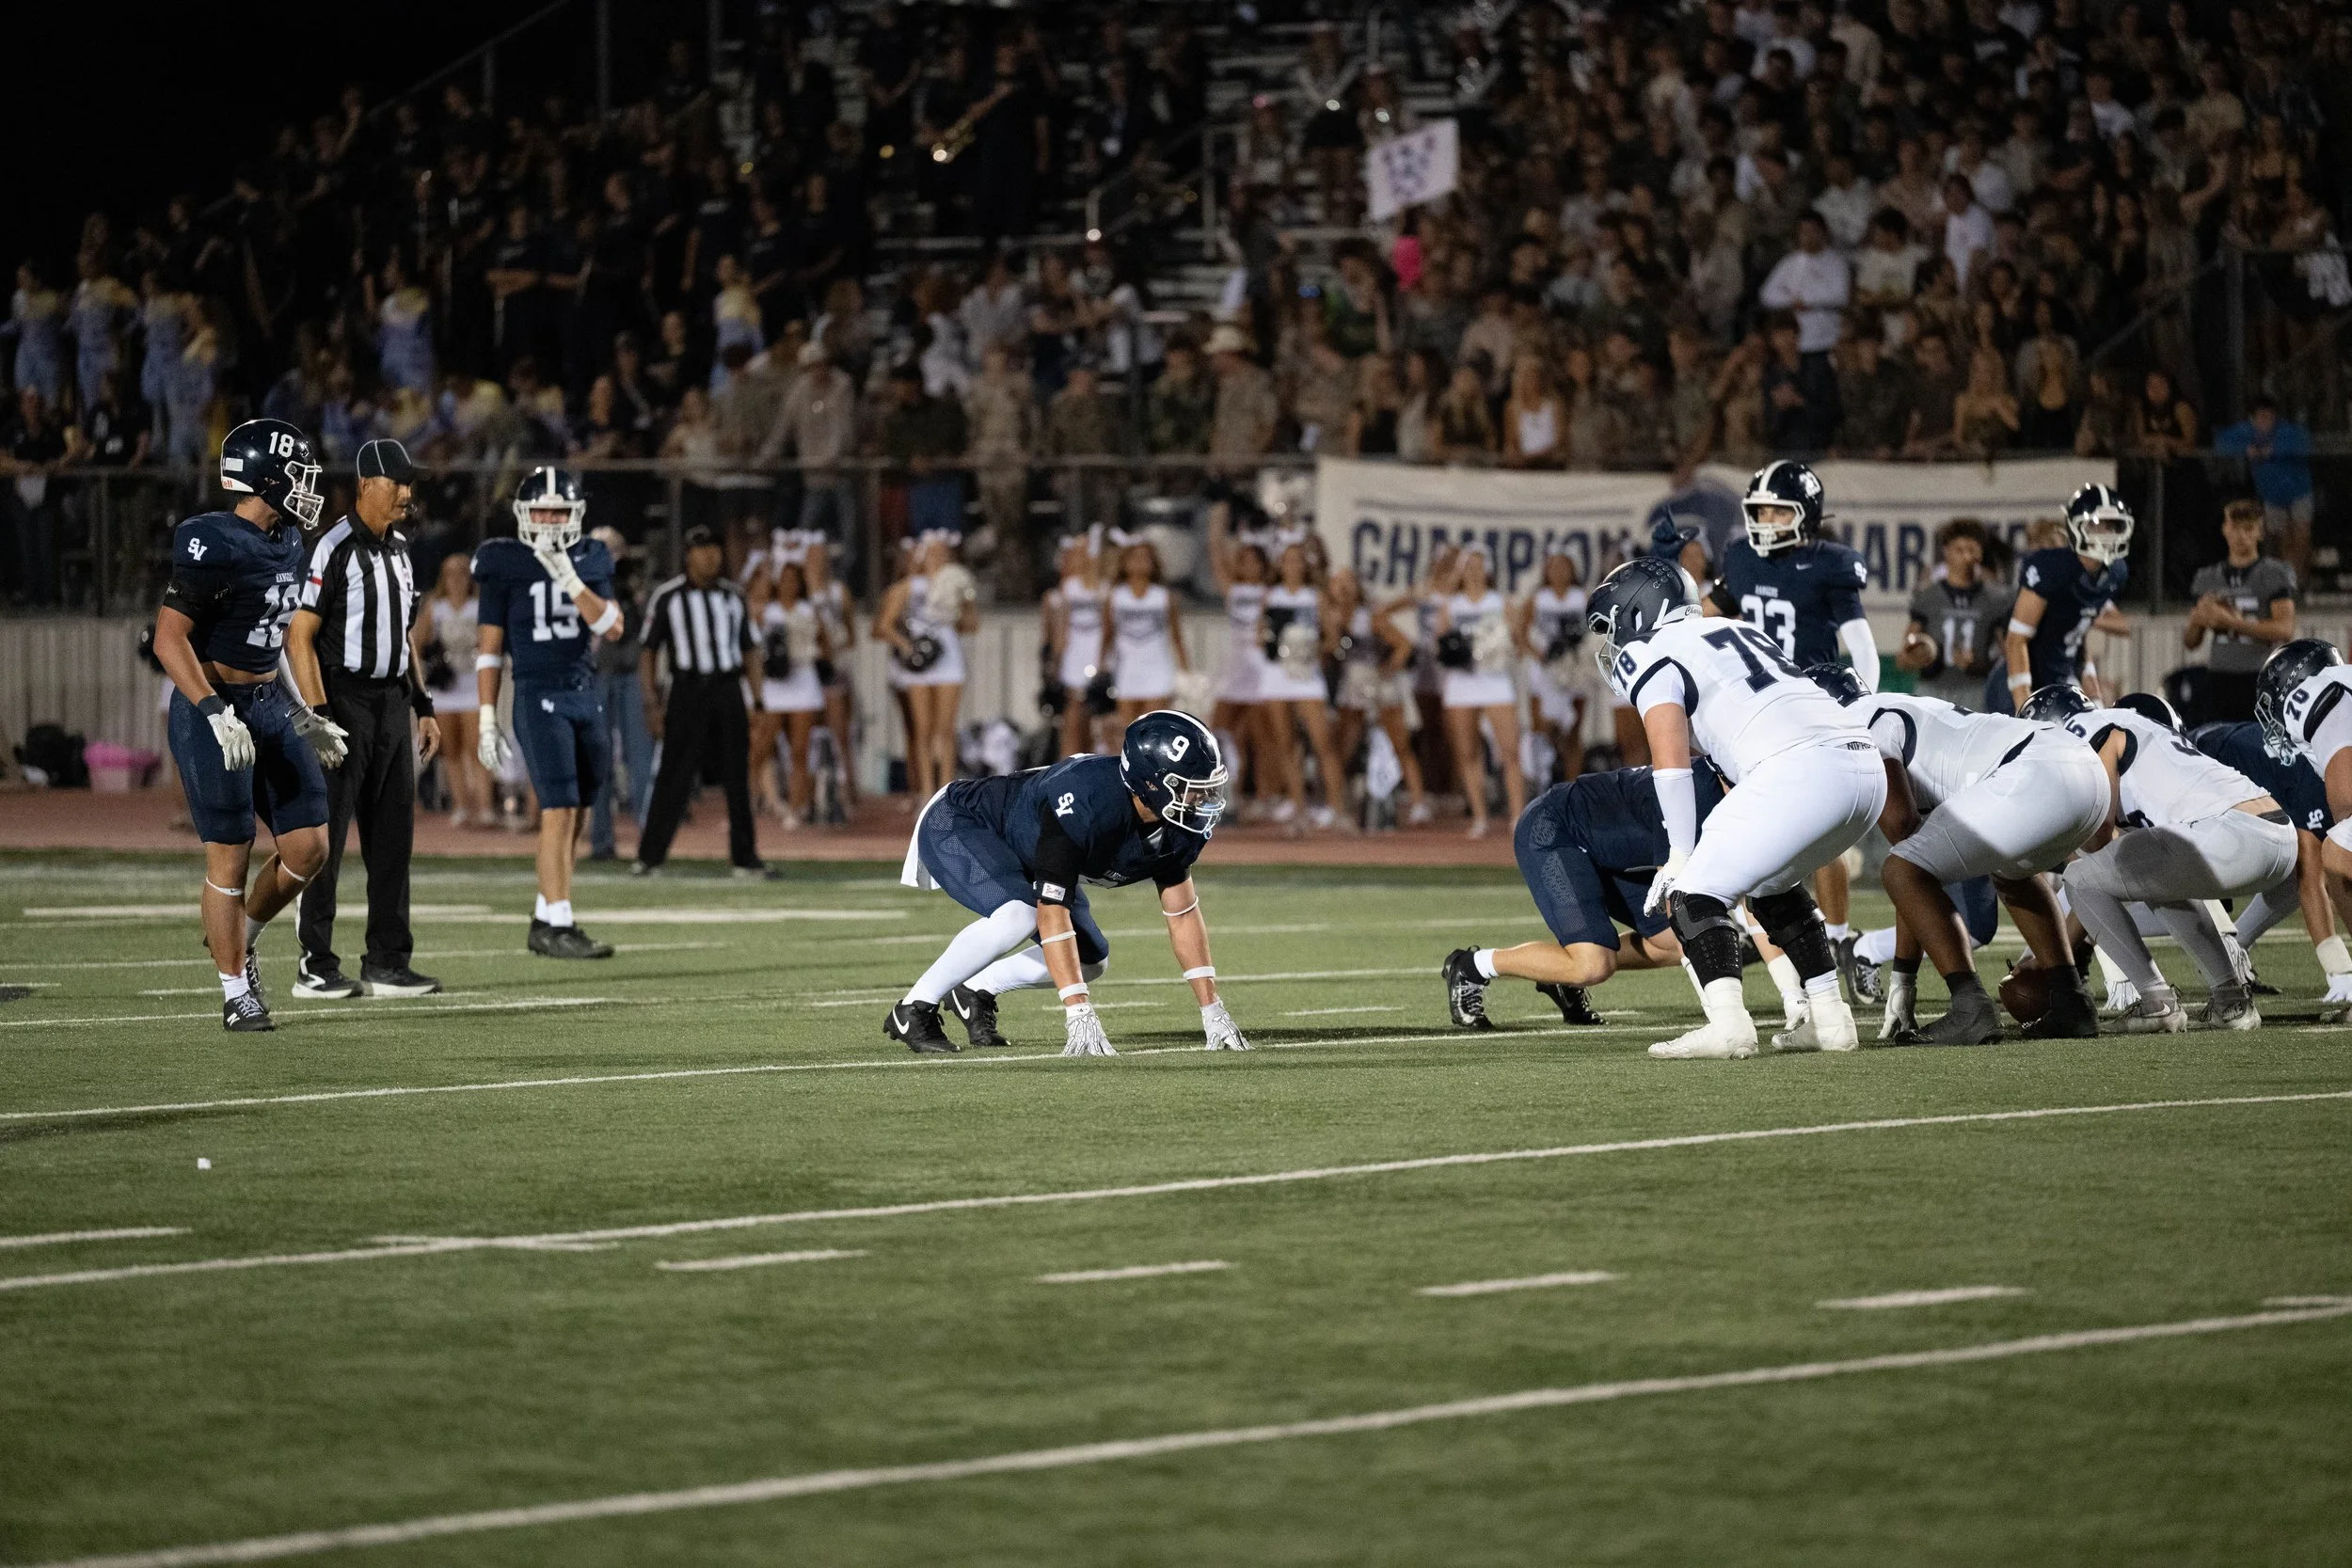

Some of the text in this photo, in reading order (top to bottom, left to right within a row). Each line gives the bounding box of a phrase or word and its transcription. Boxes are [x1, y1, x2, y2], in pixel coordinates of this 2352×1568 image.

[268, 431, 294, 458] 18
[188, 537, 207, 561] SV
[246, 583, 303, 648] 18
[529, 580, 581, 641] 15
[1613, 650, 1638, 691] 78
[1700, 626, 1809, 694] 78
[2284, 688, 2310, 721] 70
[1166, 736, 1190, 762] 9
[1055, 792, 1075, 818] SV
[2306, 808, 2325, 831] SV
